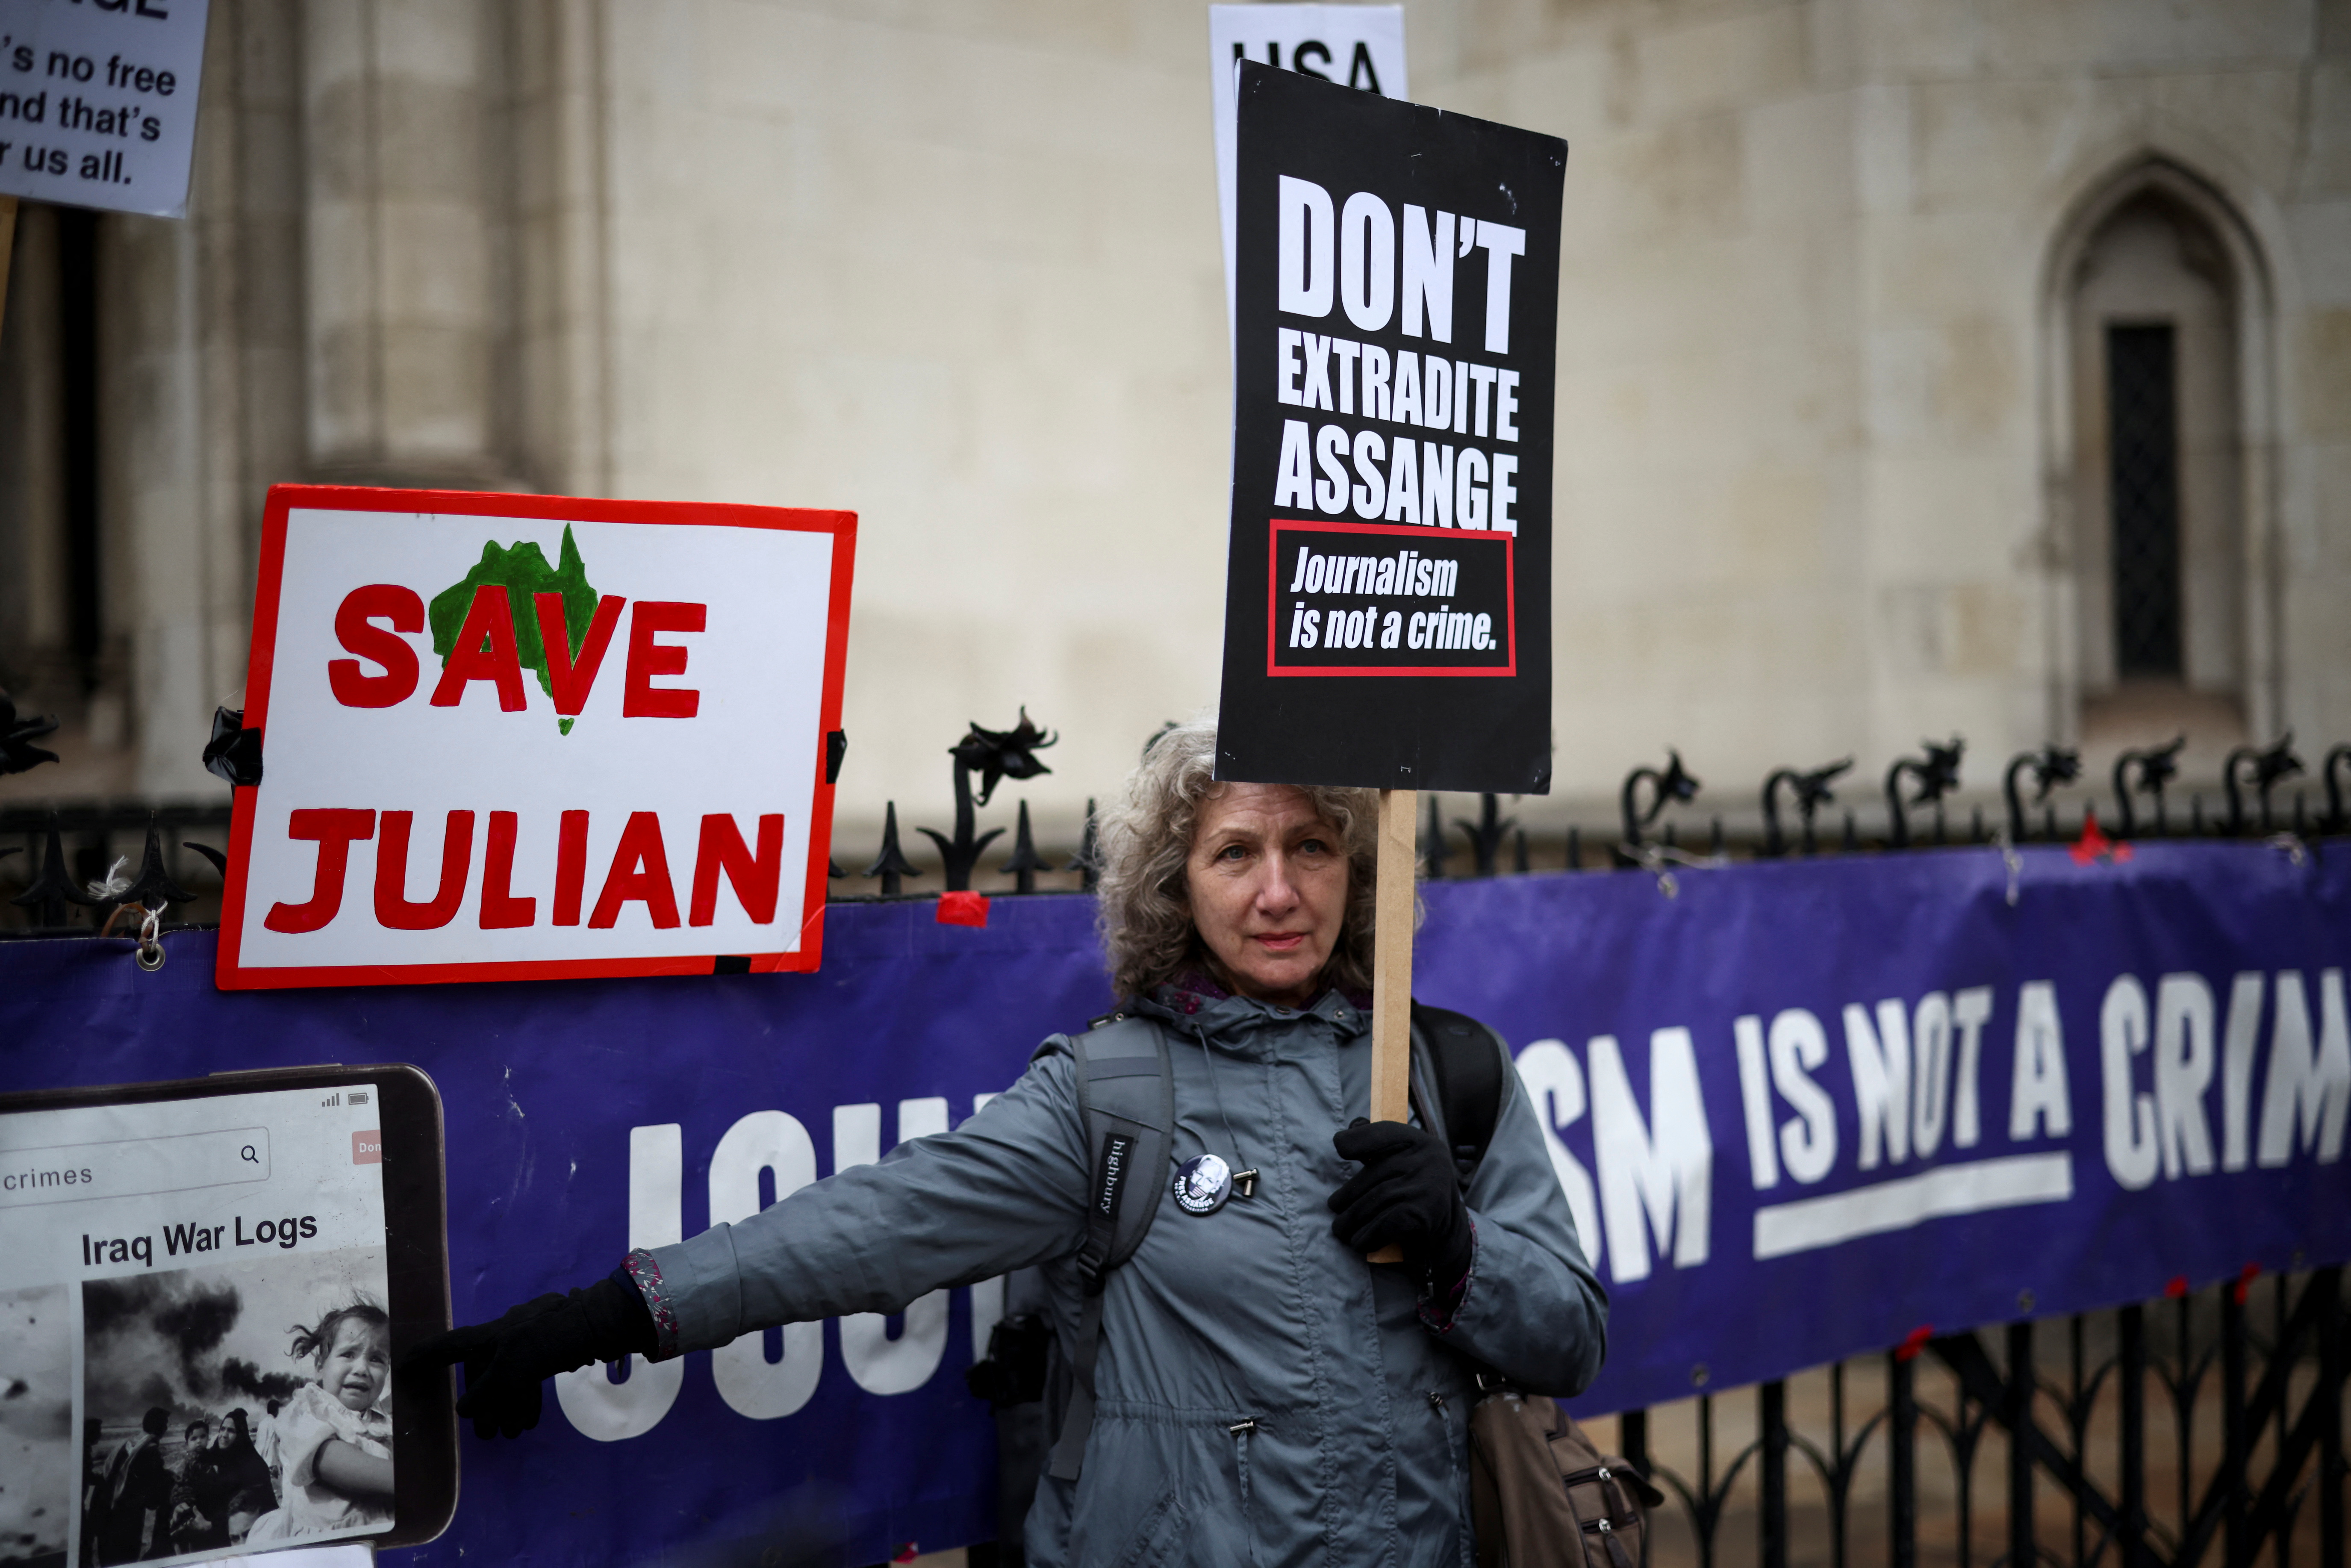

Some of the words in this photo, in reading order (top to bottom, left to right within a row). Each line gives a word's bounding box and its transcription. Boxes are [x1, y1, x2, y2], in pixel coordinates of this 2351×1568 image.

[47, 50, 95, 82] no
[107, 54, 177, 96] free
[59, 97, 162, 142] that's
[24, 145, 69, 176] us
[80, 150, 132, 185] all.
[1279, 174, 1526, 355] DON'T
[1278, 327, 1520, 442] EXTRADITE
[1274, 419, 1518, 537] ASSANGE
[1290, 546, 1458, 597] Journalism
[328, 584, 707, 718] SAVE
[1289, 601, 1320, 648] is
[1324, 606, 1378, 649] not
[1380, 610, 1402, 649] a
[1407, 604, 1496, 650] crime.
[263, 808, 785, 934] JULIAN
[1733, 1007, 1838, 1191] IS
[1842, 984, 1995, 1171] NOT
[2009, 979, 2072, 1142] A
[4, 1168, 92, 1191] crimes
[1100, 1139, 1126, 1214] highbury
[1181, 1194, 1215, 1208] ASSANGE
[82, 1232, 153, 1267] Iraq
[163, 1221, 225, 1256] War
[235, 1214, 318, 1249] Logs
